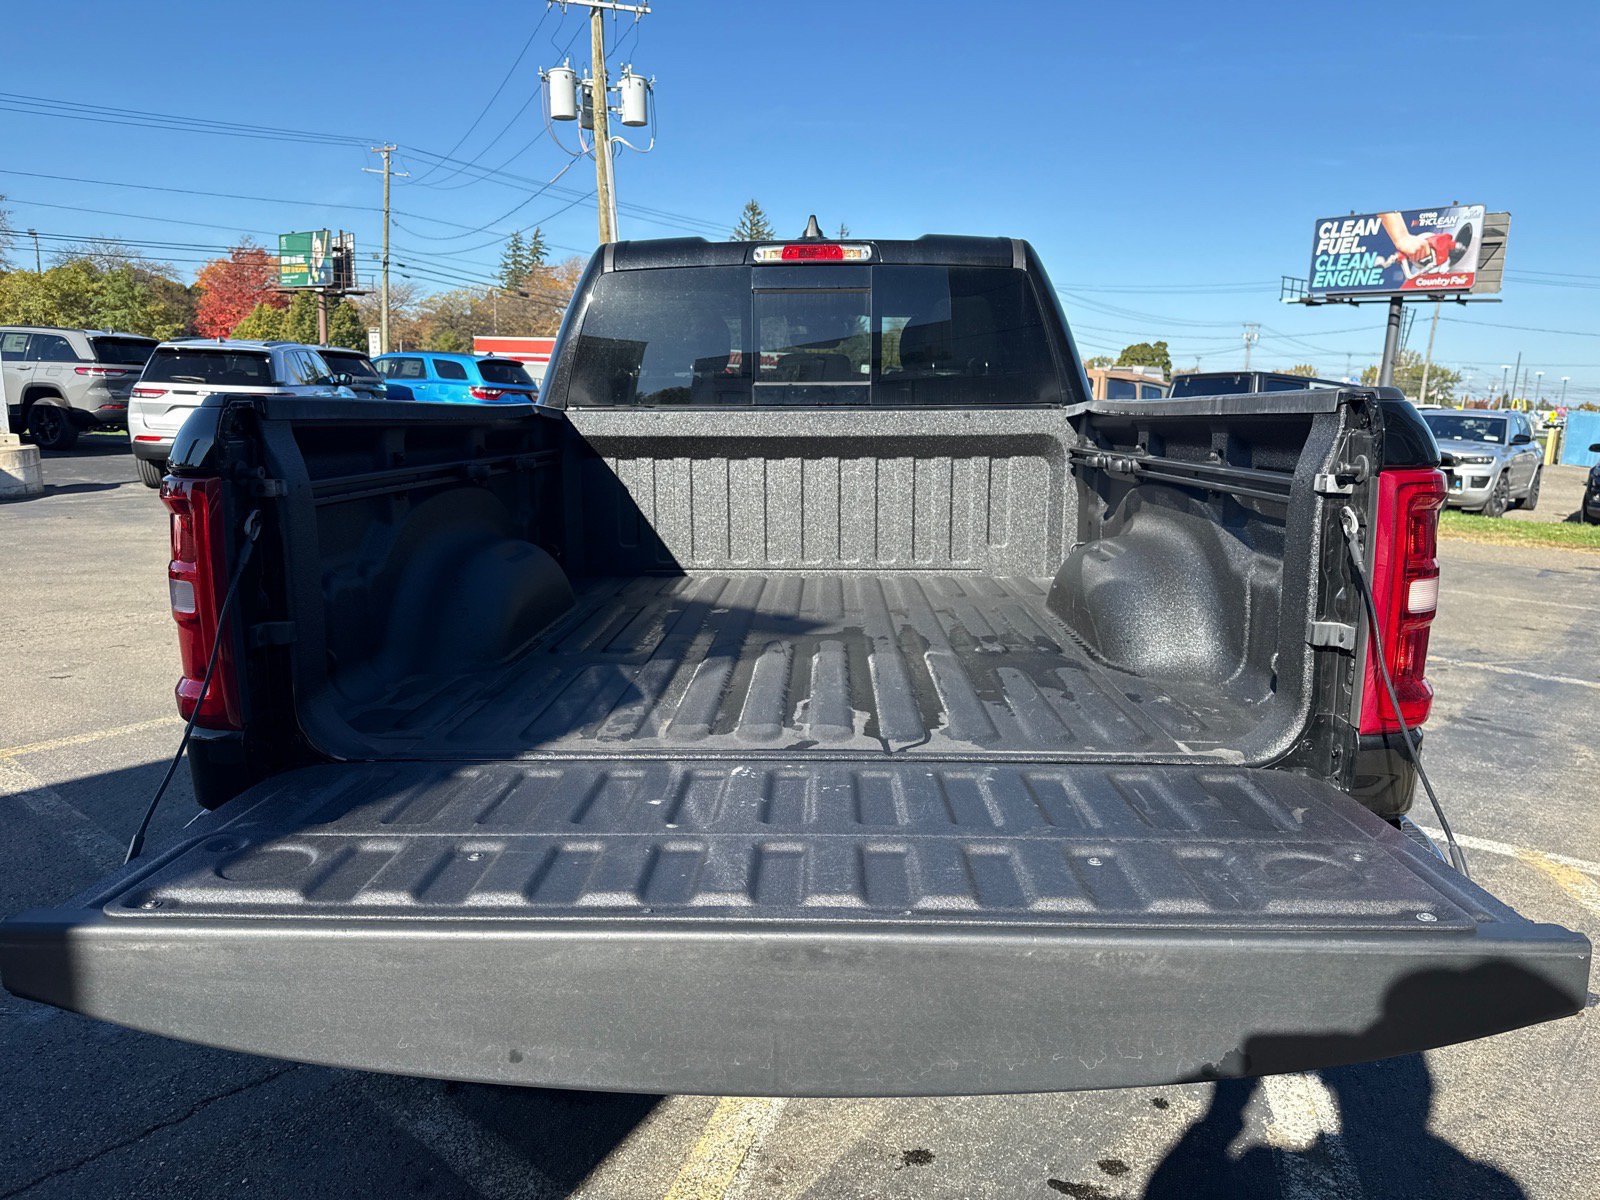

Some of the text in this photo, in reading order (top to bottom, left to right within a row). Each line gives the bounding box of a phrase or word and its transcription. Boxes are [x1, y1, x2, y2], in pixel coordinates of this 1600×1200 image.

[1318, 218, 1382, 239] CLEAN
[1315, 236, 1367, 256] FUEL.
[1315, 252, 1377, 271] CLEAN
[1311, 268, 1385, 288] ENGINE.
[1415, 276, 1450, 287] Country
